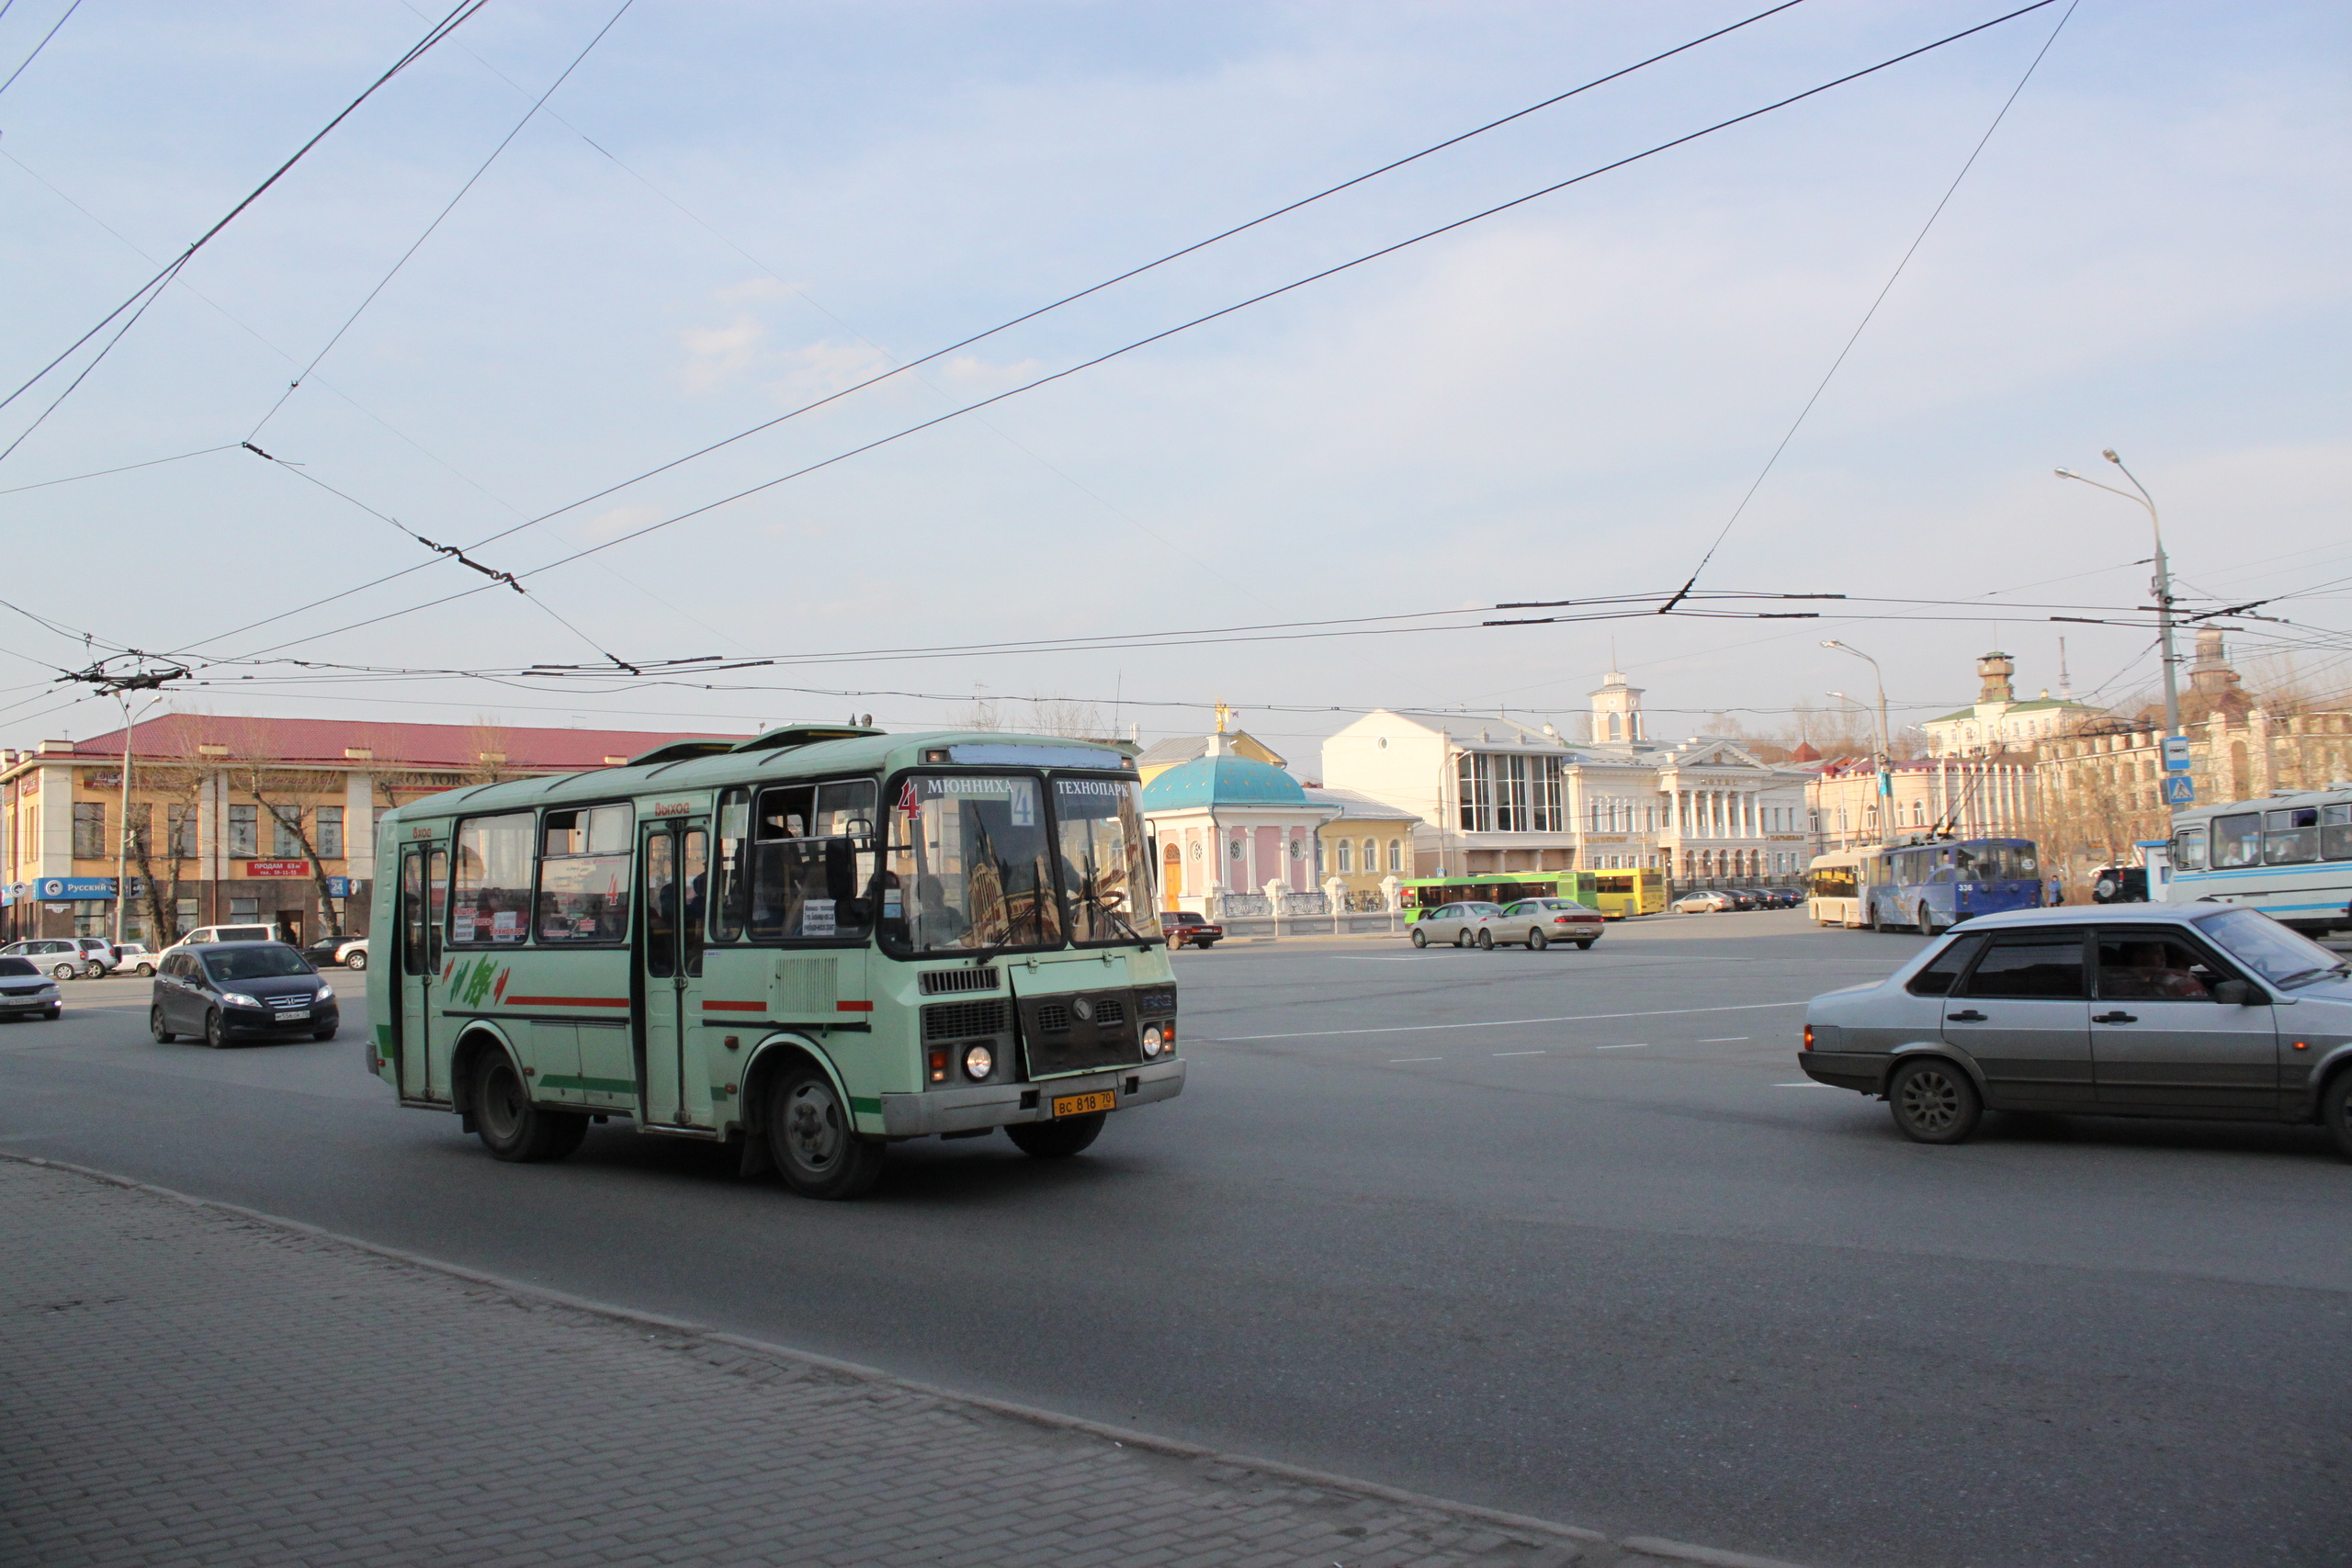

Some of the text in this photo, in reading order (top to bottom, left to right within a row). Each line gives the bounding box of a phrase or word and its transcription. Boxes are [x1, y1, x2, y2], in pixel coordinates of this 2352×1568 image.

[1057, 781, 1129, 797] ТЕХНОПАРК
[898, 779, 1031, 824] 4 МЮННИХА 4
[67, 884, 107, 892] Русский
[605, 873, 618, 906] 4
[1958, 884, 1973, 892] 336
[489, 926, 526, 938] Технопарк
[1059, 1093, 1111, 1113] ВС 818 70
